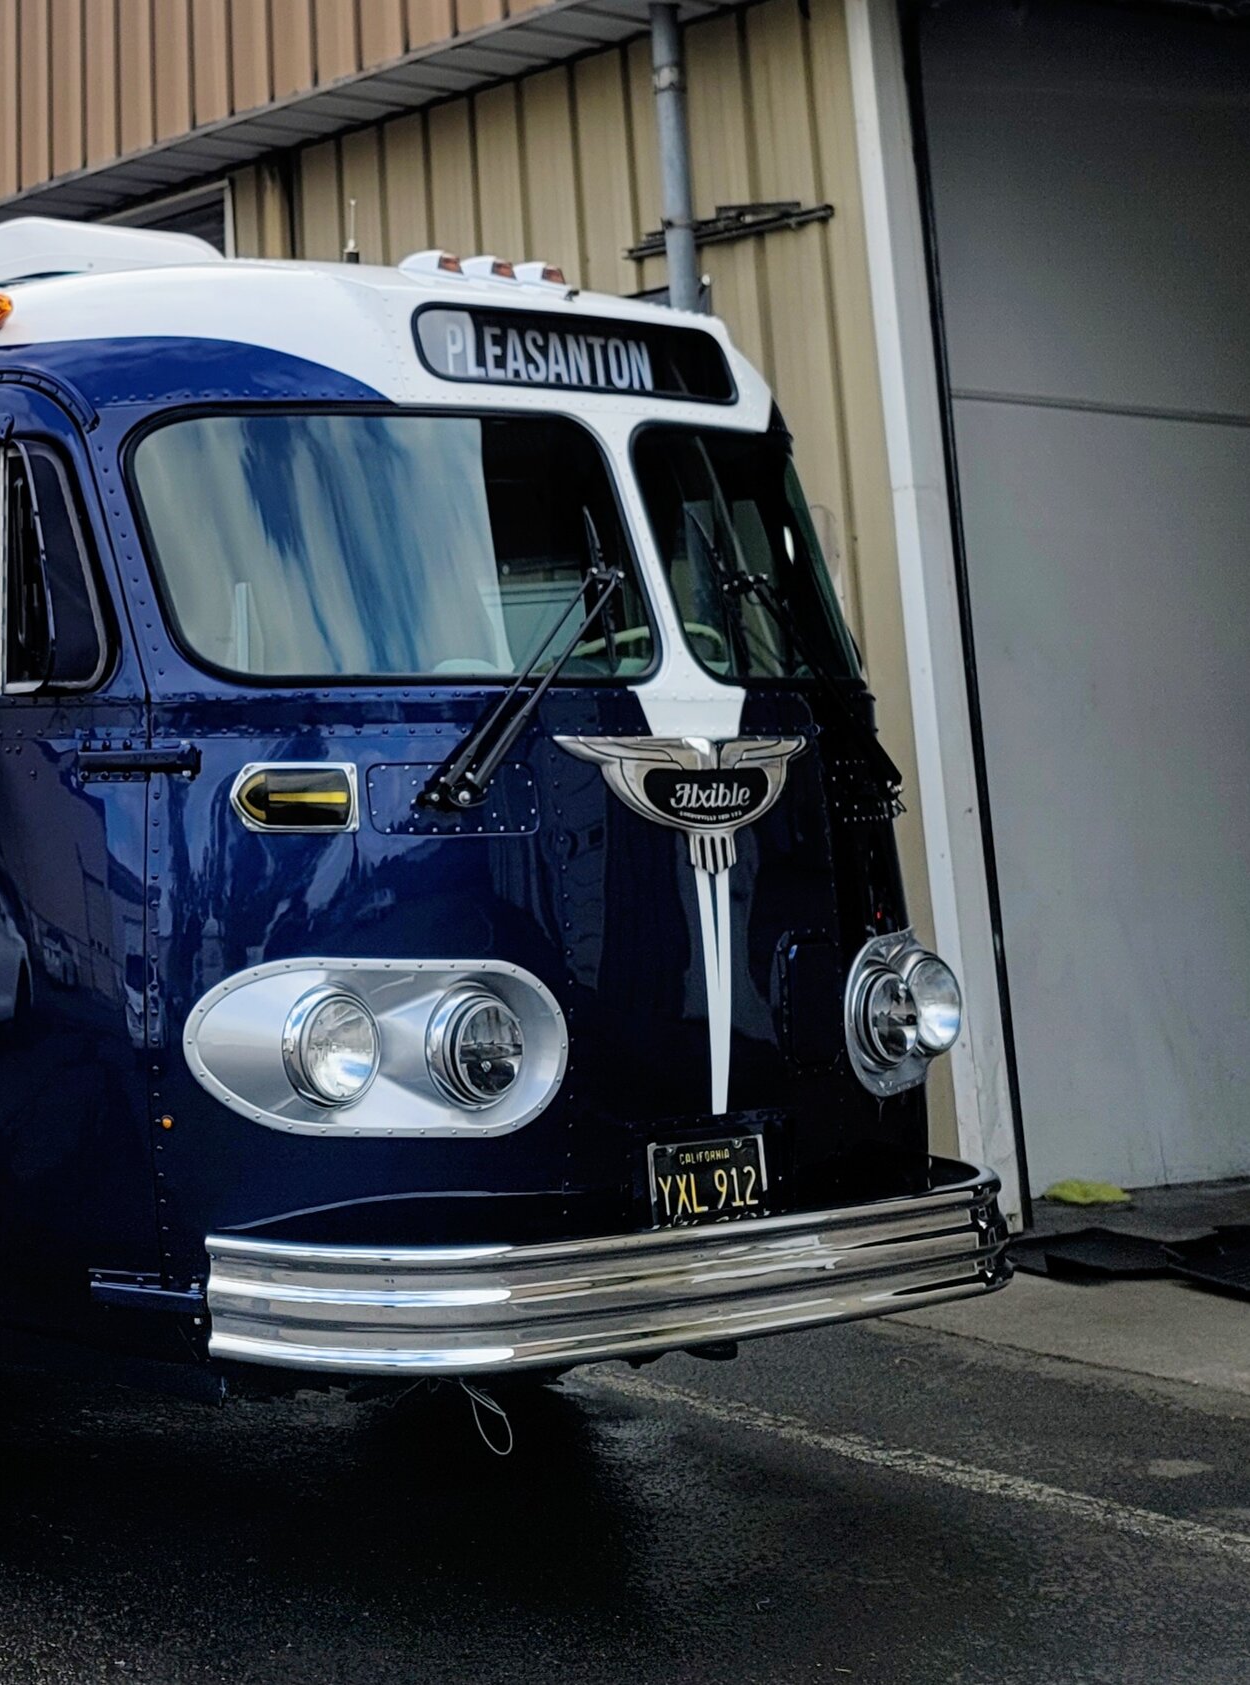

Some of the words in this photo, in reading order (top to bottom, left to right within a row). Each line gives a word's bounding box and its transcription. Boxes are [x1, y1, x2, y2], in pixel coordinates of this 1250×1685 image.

[446, 323, 654, 392] PLEASANTON
[679, 1148, 731, 1165] CALIFORNIA
[658, 1171, 709, 1216] YXL
[714, 1165, 759, 1210] 912
